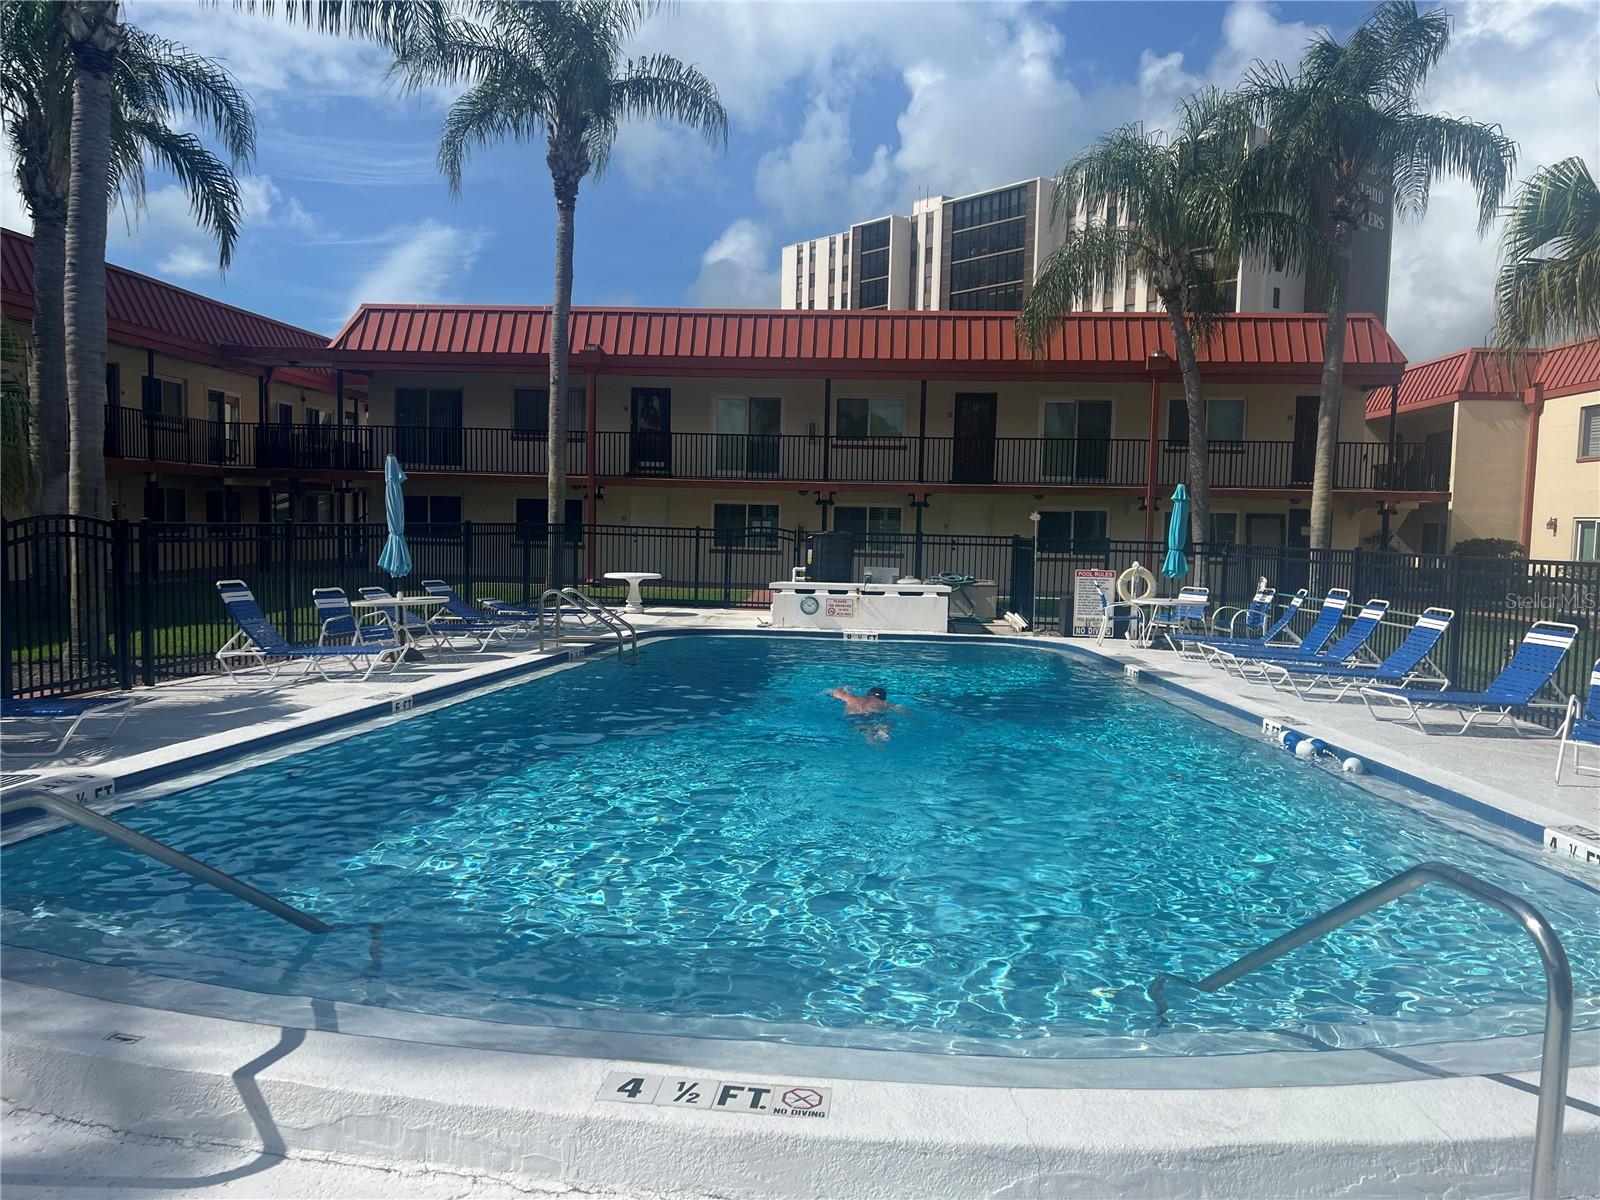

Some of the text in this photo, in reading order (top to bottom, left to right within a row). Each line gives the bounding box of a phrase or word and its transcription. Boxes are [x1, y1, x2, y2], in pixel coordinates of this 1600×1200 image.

[616, 1077, 646, 1099] 4
[773, 1107, 826, 1119] NO DIVING
